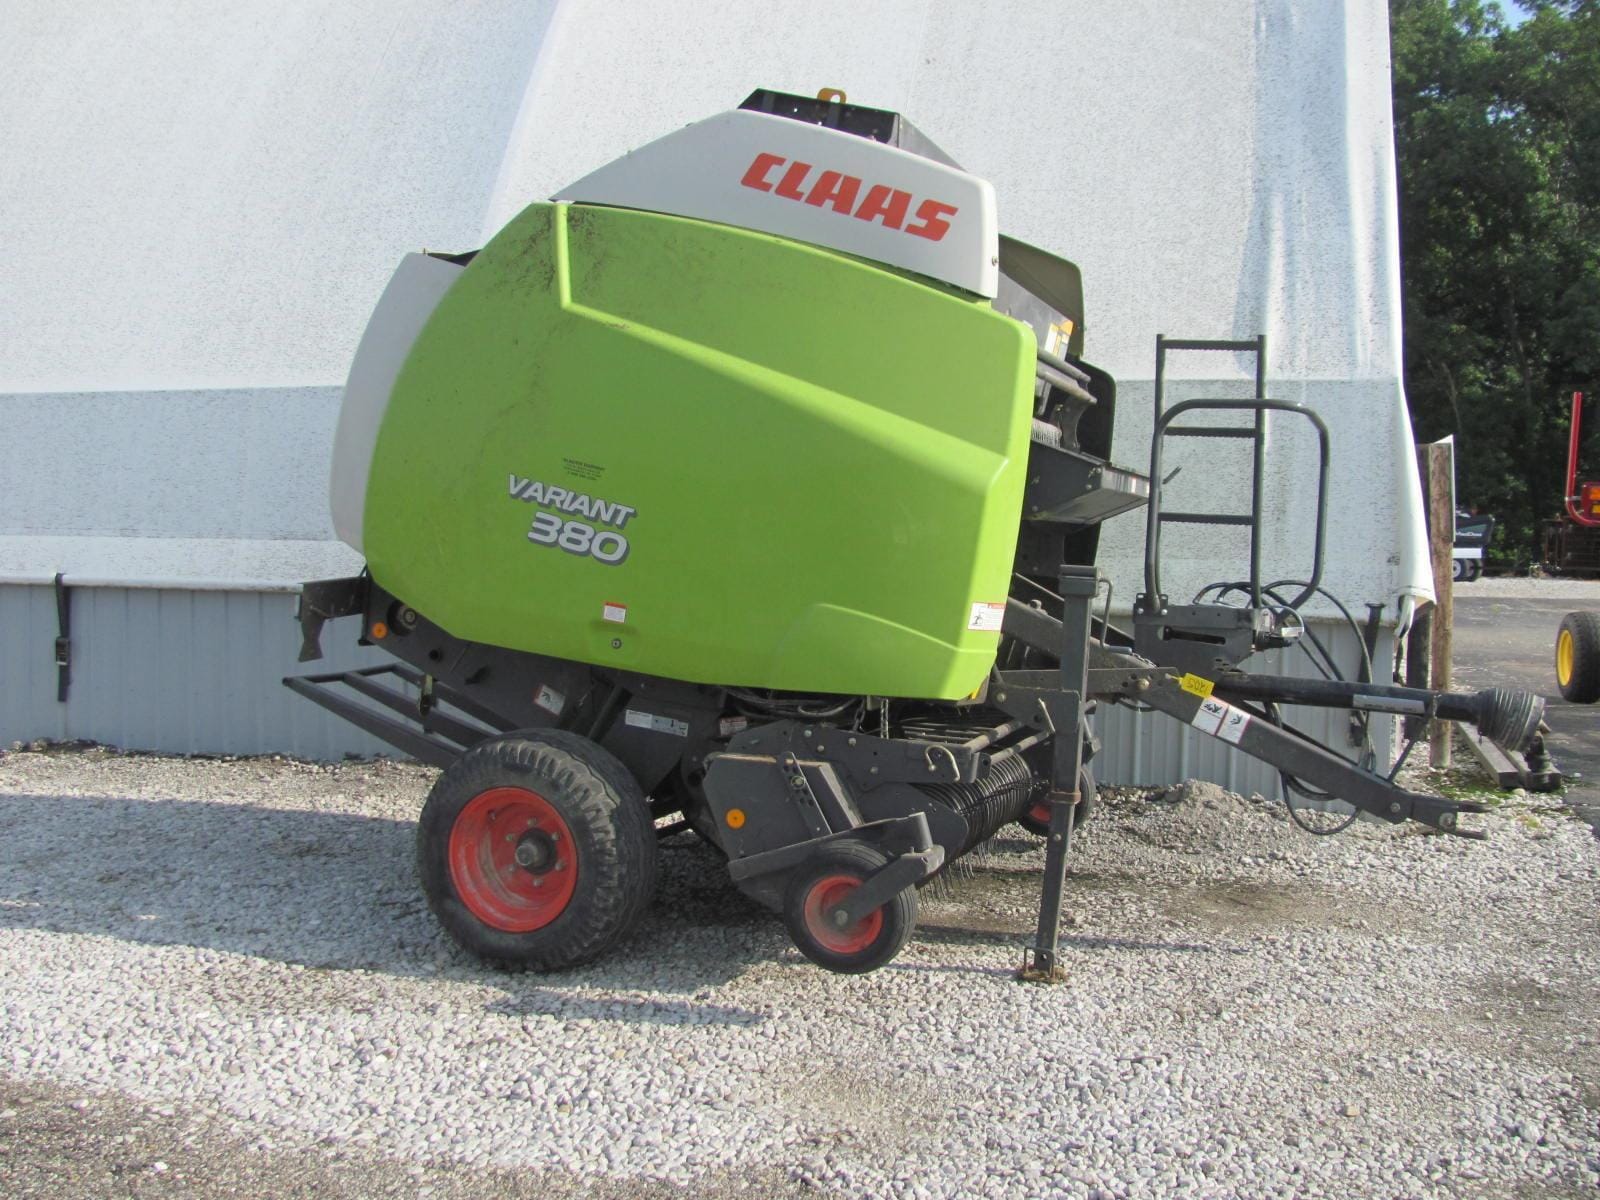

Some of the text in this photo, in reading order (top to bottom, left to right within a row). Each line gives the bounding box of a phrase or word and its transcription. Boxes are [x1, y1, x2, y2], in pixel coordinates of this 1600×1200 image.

[741, 152, 959, 241] CLAAS
[508, 473, 636, 528] VARIANT
[527, 511, 629, 565] 380
